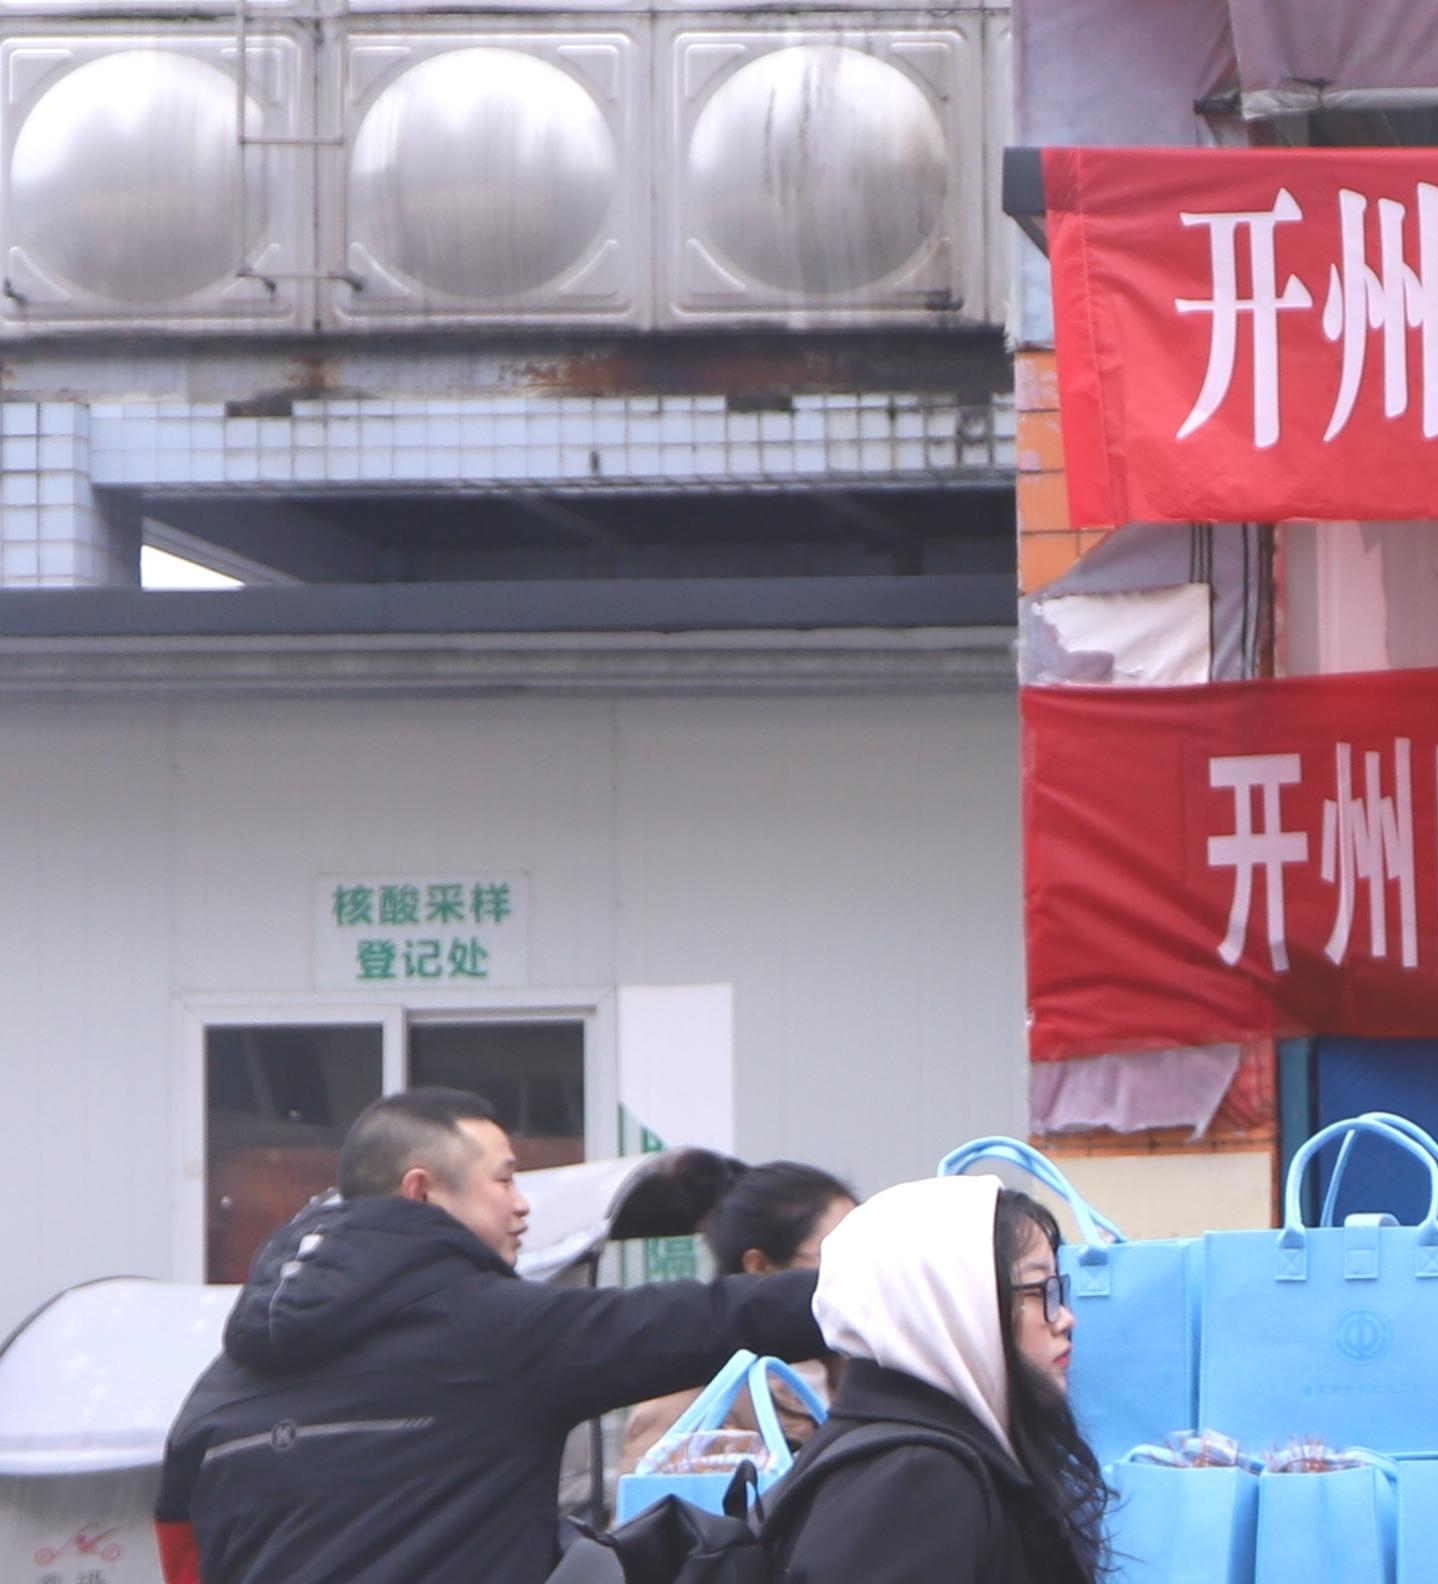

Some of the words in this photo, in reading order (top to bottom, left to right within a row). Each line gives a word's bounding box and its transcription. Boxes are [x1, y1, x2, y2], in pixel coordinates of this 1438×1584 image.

[332, 883, 513, 926] 核酸采样
[355, 937, 489, 981] 登记处
